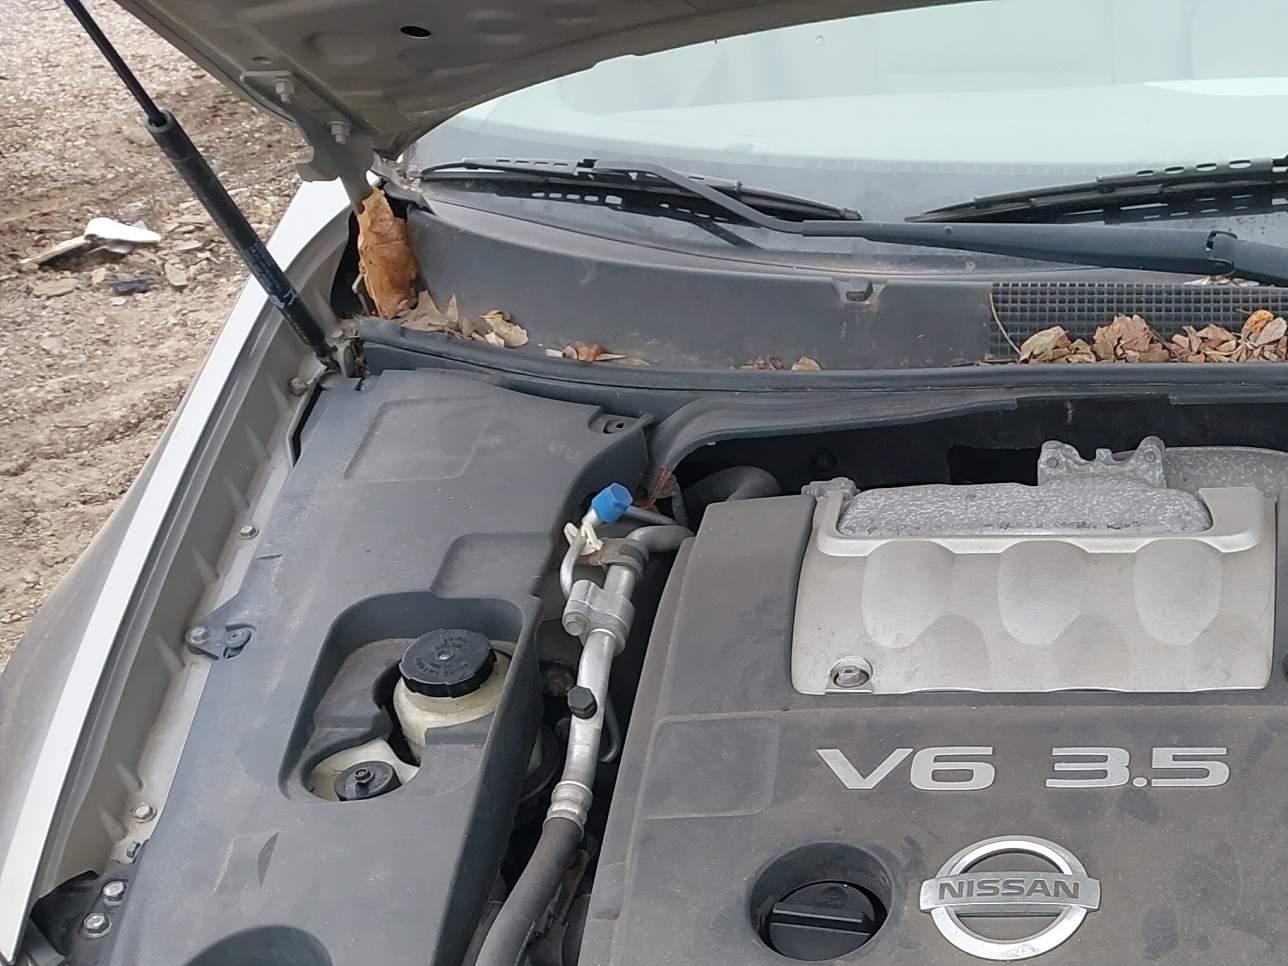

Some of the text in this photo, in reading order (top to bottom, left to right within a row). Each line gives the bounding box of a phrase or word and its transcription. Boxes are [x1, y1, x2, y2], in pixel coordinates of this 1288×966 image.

[816, 747, 1230, 791] V6 3.5
[938, 878, 1080, 899] NISSAN
